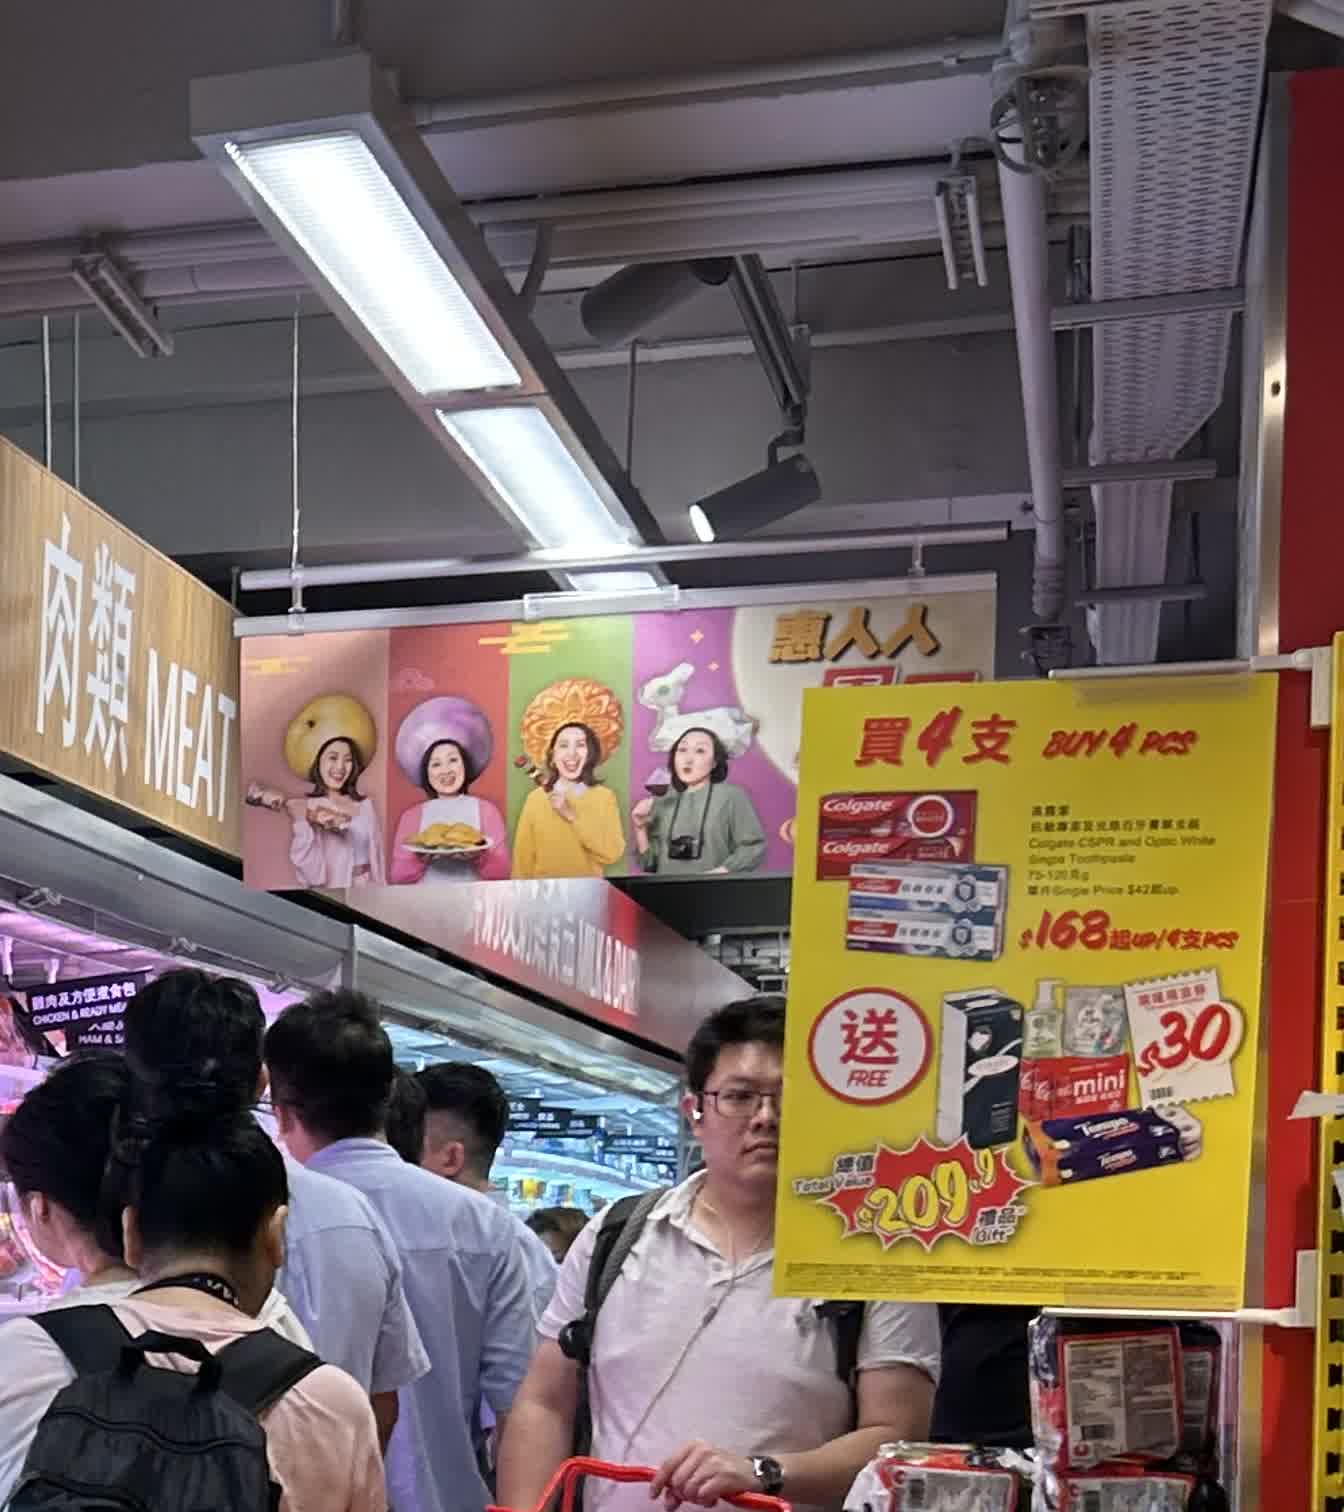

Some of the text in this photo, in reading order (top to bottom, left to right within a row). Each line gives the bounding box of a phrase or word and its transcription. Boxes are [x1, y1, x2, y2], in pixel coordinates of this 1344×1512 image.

[37, 511, 136, 776] 肉類
[768, 604, 942, 664] 惠人人
[144, 648, 237, 823] MEAT
[853, 705, 1017, 768] 買4支
[1041, 721, 1199, 760] BUY 4 PCS
[823, 798, 894, 816] Colgate
[822, 840, 890, 857] Colgate
[31, 1011, 70, 1026] CHICKEN
[71, 1009, 80, 1020] &
[79, 1005, 108, 1018] READY
[839, 1007, 900, 1066] 送
[1136, 1003, 1232, 1078] $30
[846, 1069, 892, 1088] FREE
[1073, 1071, 1126, 1097] mini
[793, 1175, 873, 1193] Total Value
[975, 1226, 1014, 1243] Gift
